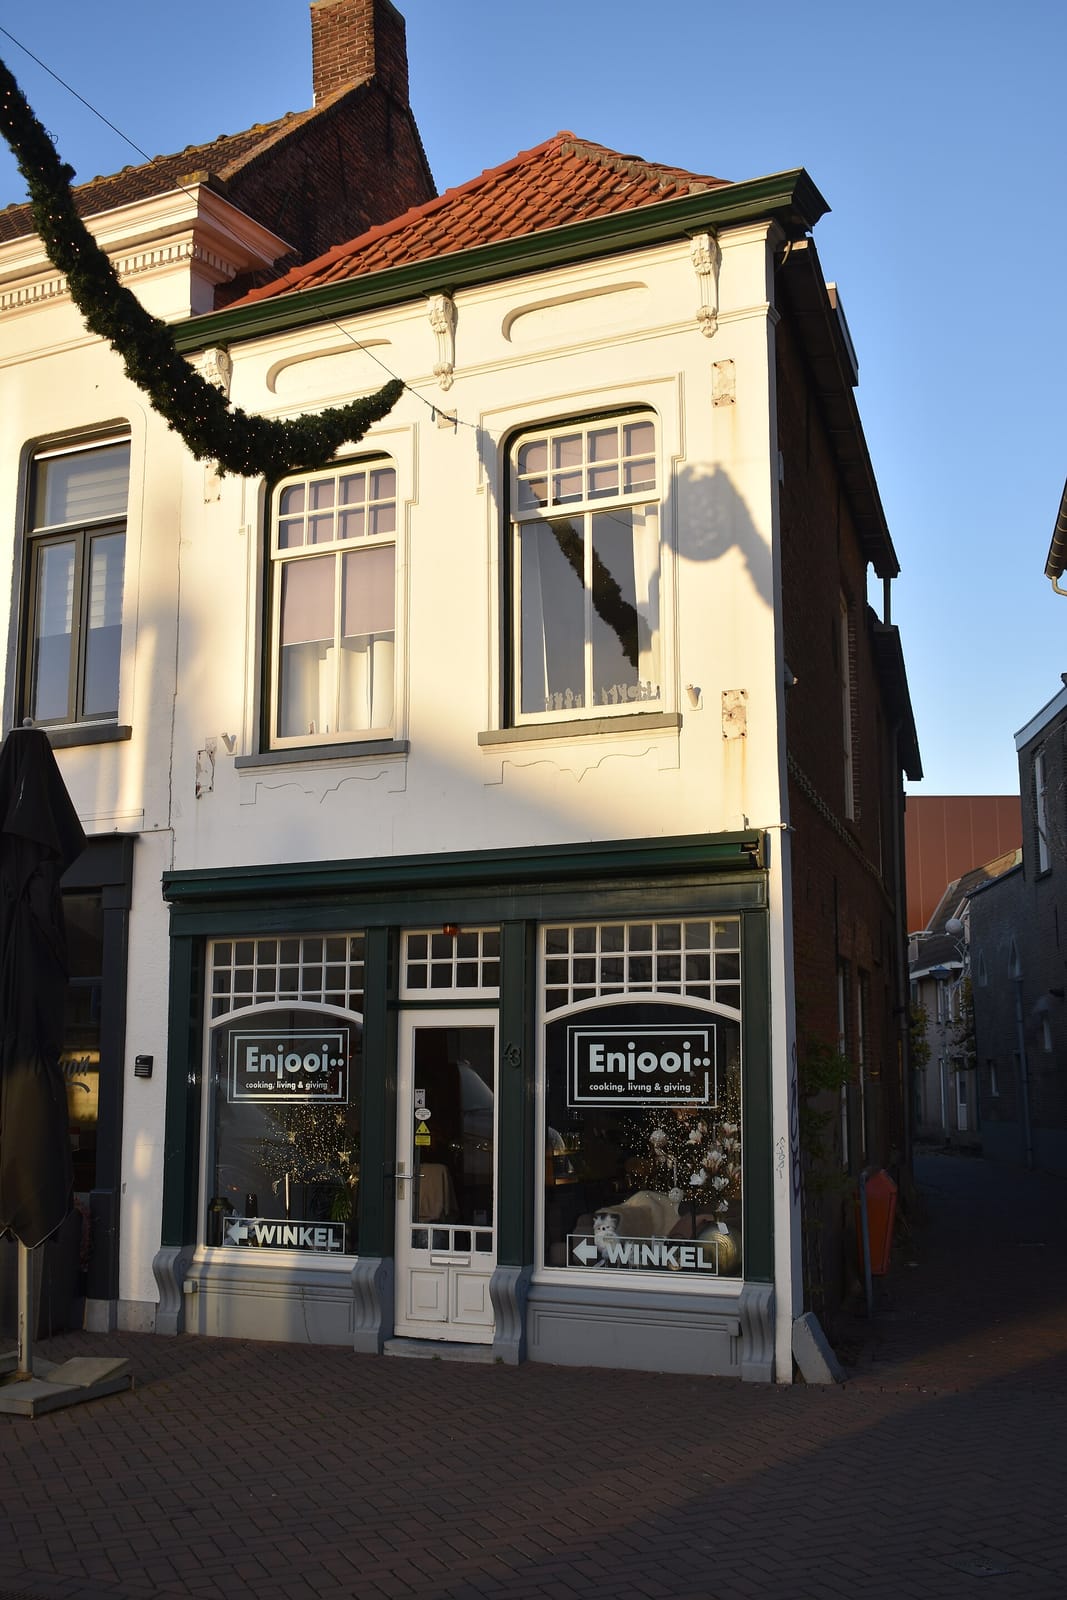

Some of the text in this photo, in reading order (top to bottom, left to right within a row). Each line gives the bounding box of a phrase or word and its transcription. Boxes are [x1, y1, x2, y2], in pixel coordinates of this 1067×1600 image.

[245, 1081, 328, 1090] cooking, living & giving
[589, 1082, 691, 1092] cooking, living & giving
[255, 1225, 340, 1248] WINKEL
[606, 1242, 713, 1269] WINKEL
